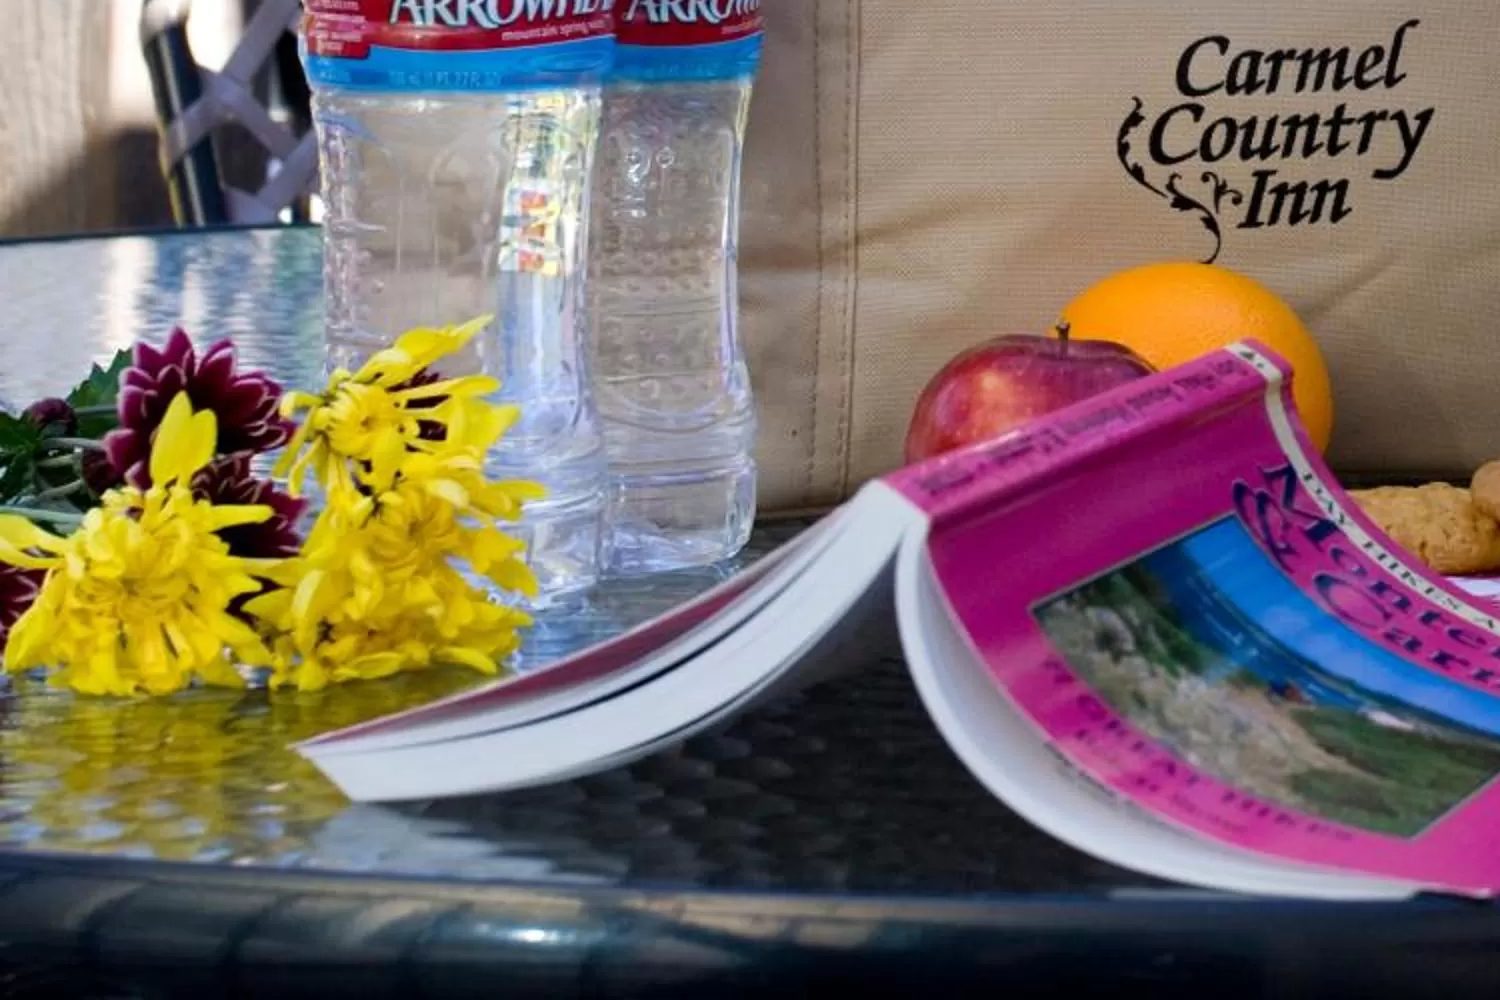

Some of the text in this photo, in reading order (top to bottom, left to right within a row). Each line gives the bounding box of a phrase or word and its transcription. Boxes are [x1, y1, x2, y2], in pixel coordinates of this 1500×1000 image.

[1175, 18, 1420, 97] Carmel
[1147, 102, 1436, 180] Country
[1236, 169, 1353, 229] Inn
